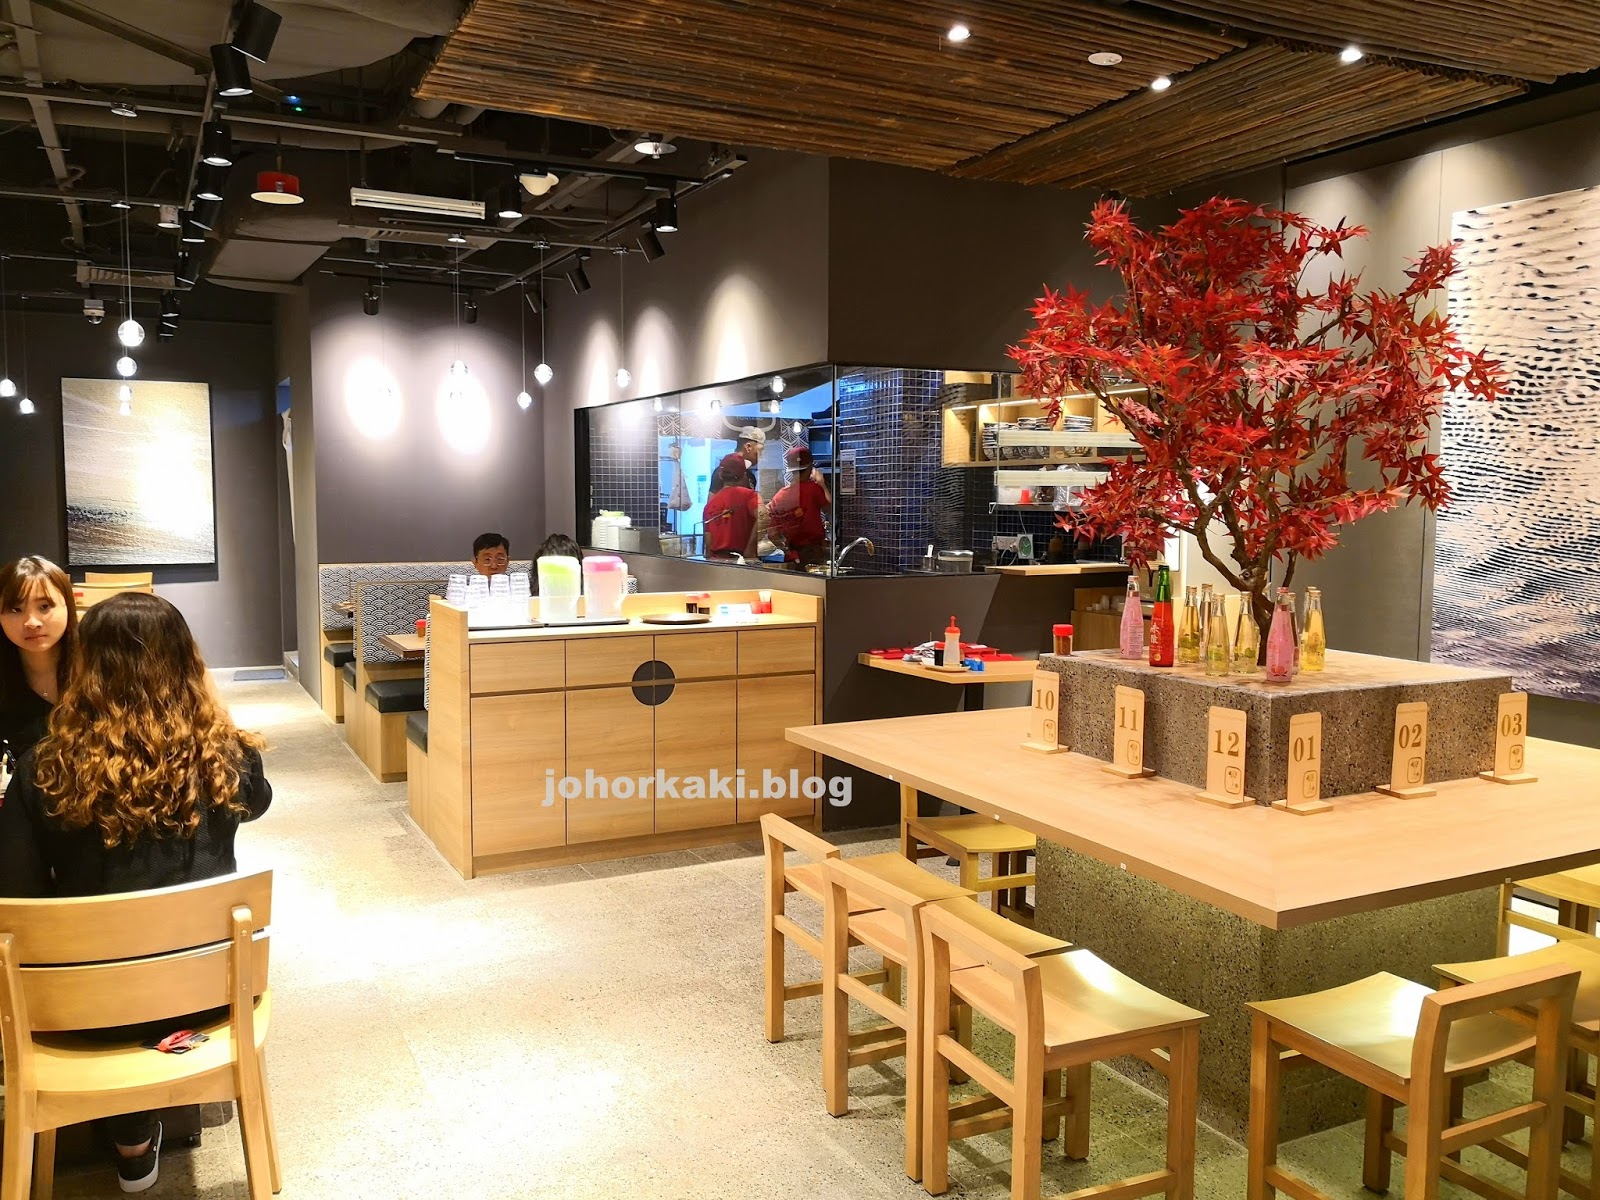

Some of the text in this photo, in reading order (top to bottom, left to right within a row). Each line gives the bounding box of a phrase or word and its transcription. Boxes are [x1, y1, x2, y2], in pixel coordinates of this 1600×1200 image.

[1035, 688, 1055, 711] 10
[1119, 706, 1138, 731] 11
[1501, 713, 1523, 737] 03
[1213, 729, 1240, 757] 12
[1293, 735, 1316, 762] 01
[1398, 723, 1422, 749] 02
